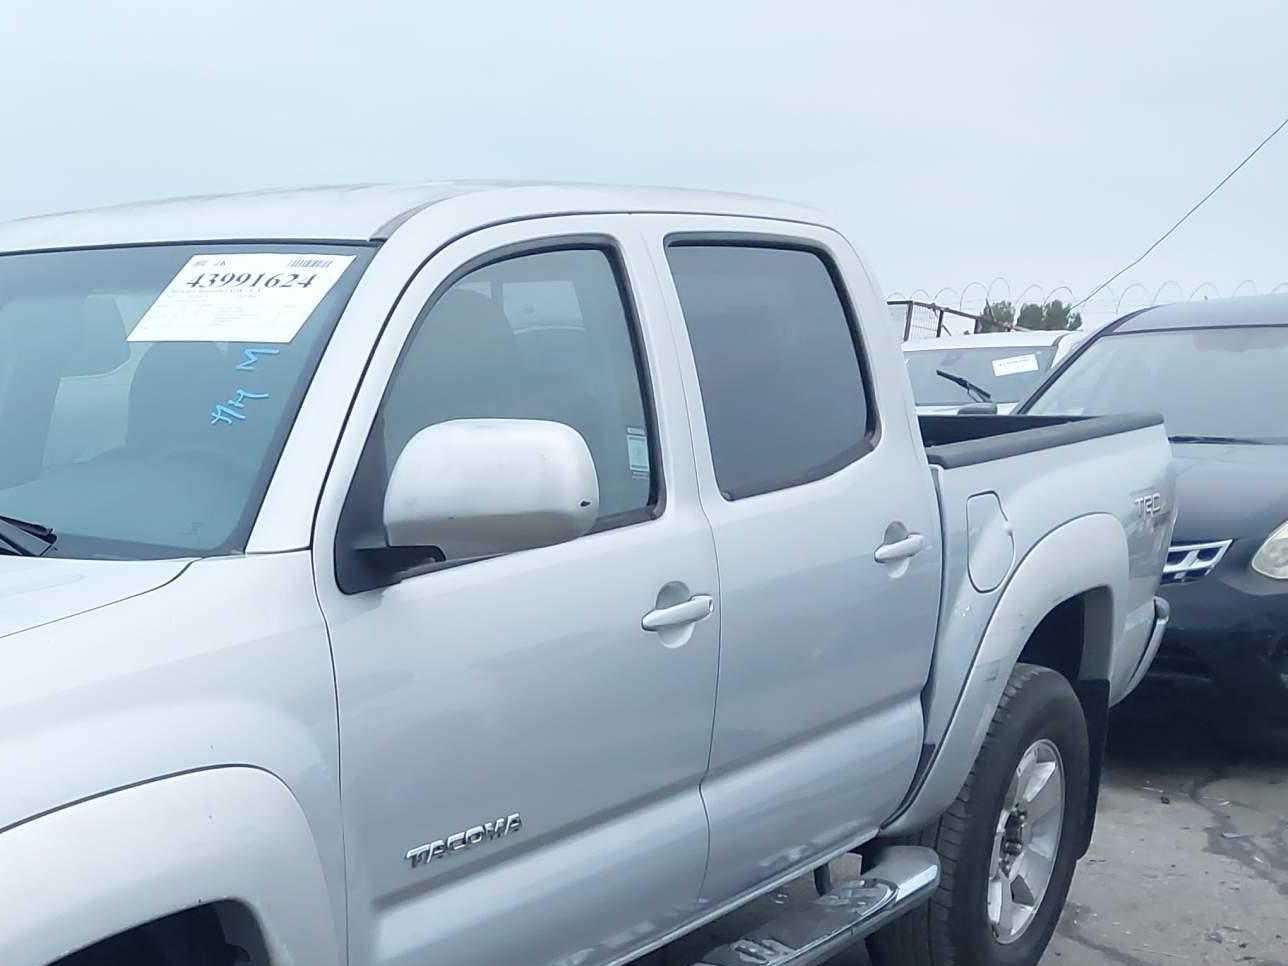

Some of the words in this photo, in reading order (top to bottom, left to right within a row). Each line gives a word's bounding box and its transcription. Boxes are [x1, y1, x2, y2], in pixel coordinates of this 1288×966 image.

[186, 272, 318, 289] 43991624
[1133, 492, 1161, 519] TRD
[404, 813, 523, 867] TACOMA
